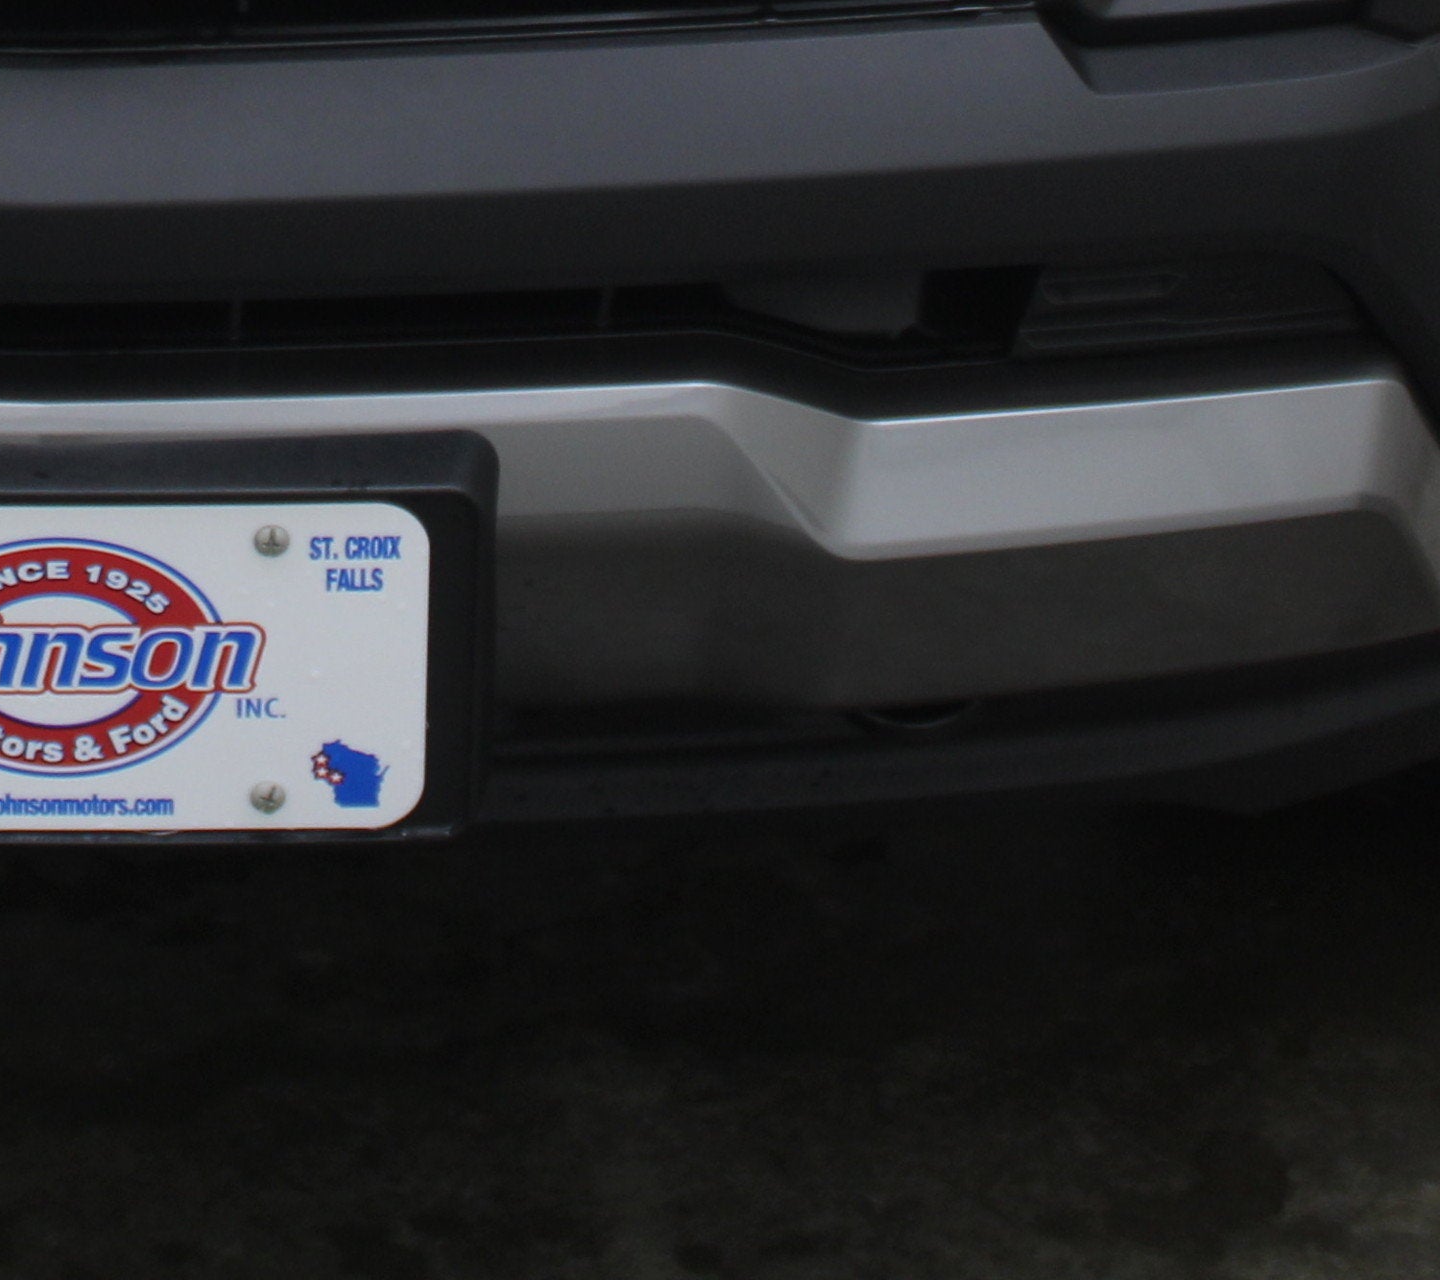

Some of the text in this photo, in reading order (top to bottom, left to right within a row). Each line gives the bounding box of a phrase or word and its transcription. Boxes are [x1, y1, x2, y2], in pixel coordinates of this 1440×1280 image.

[309, 536, 402, 561] ST. CROIX
[85, 564, 171, 615] 1925
[325, 569, 384, 592] FALLS
[235, 699, 287, 720] INC.
[74, 740, 105, 763] &
[108, 694, 190, 755] Ford
